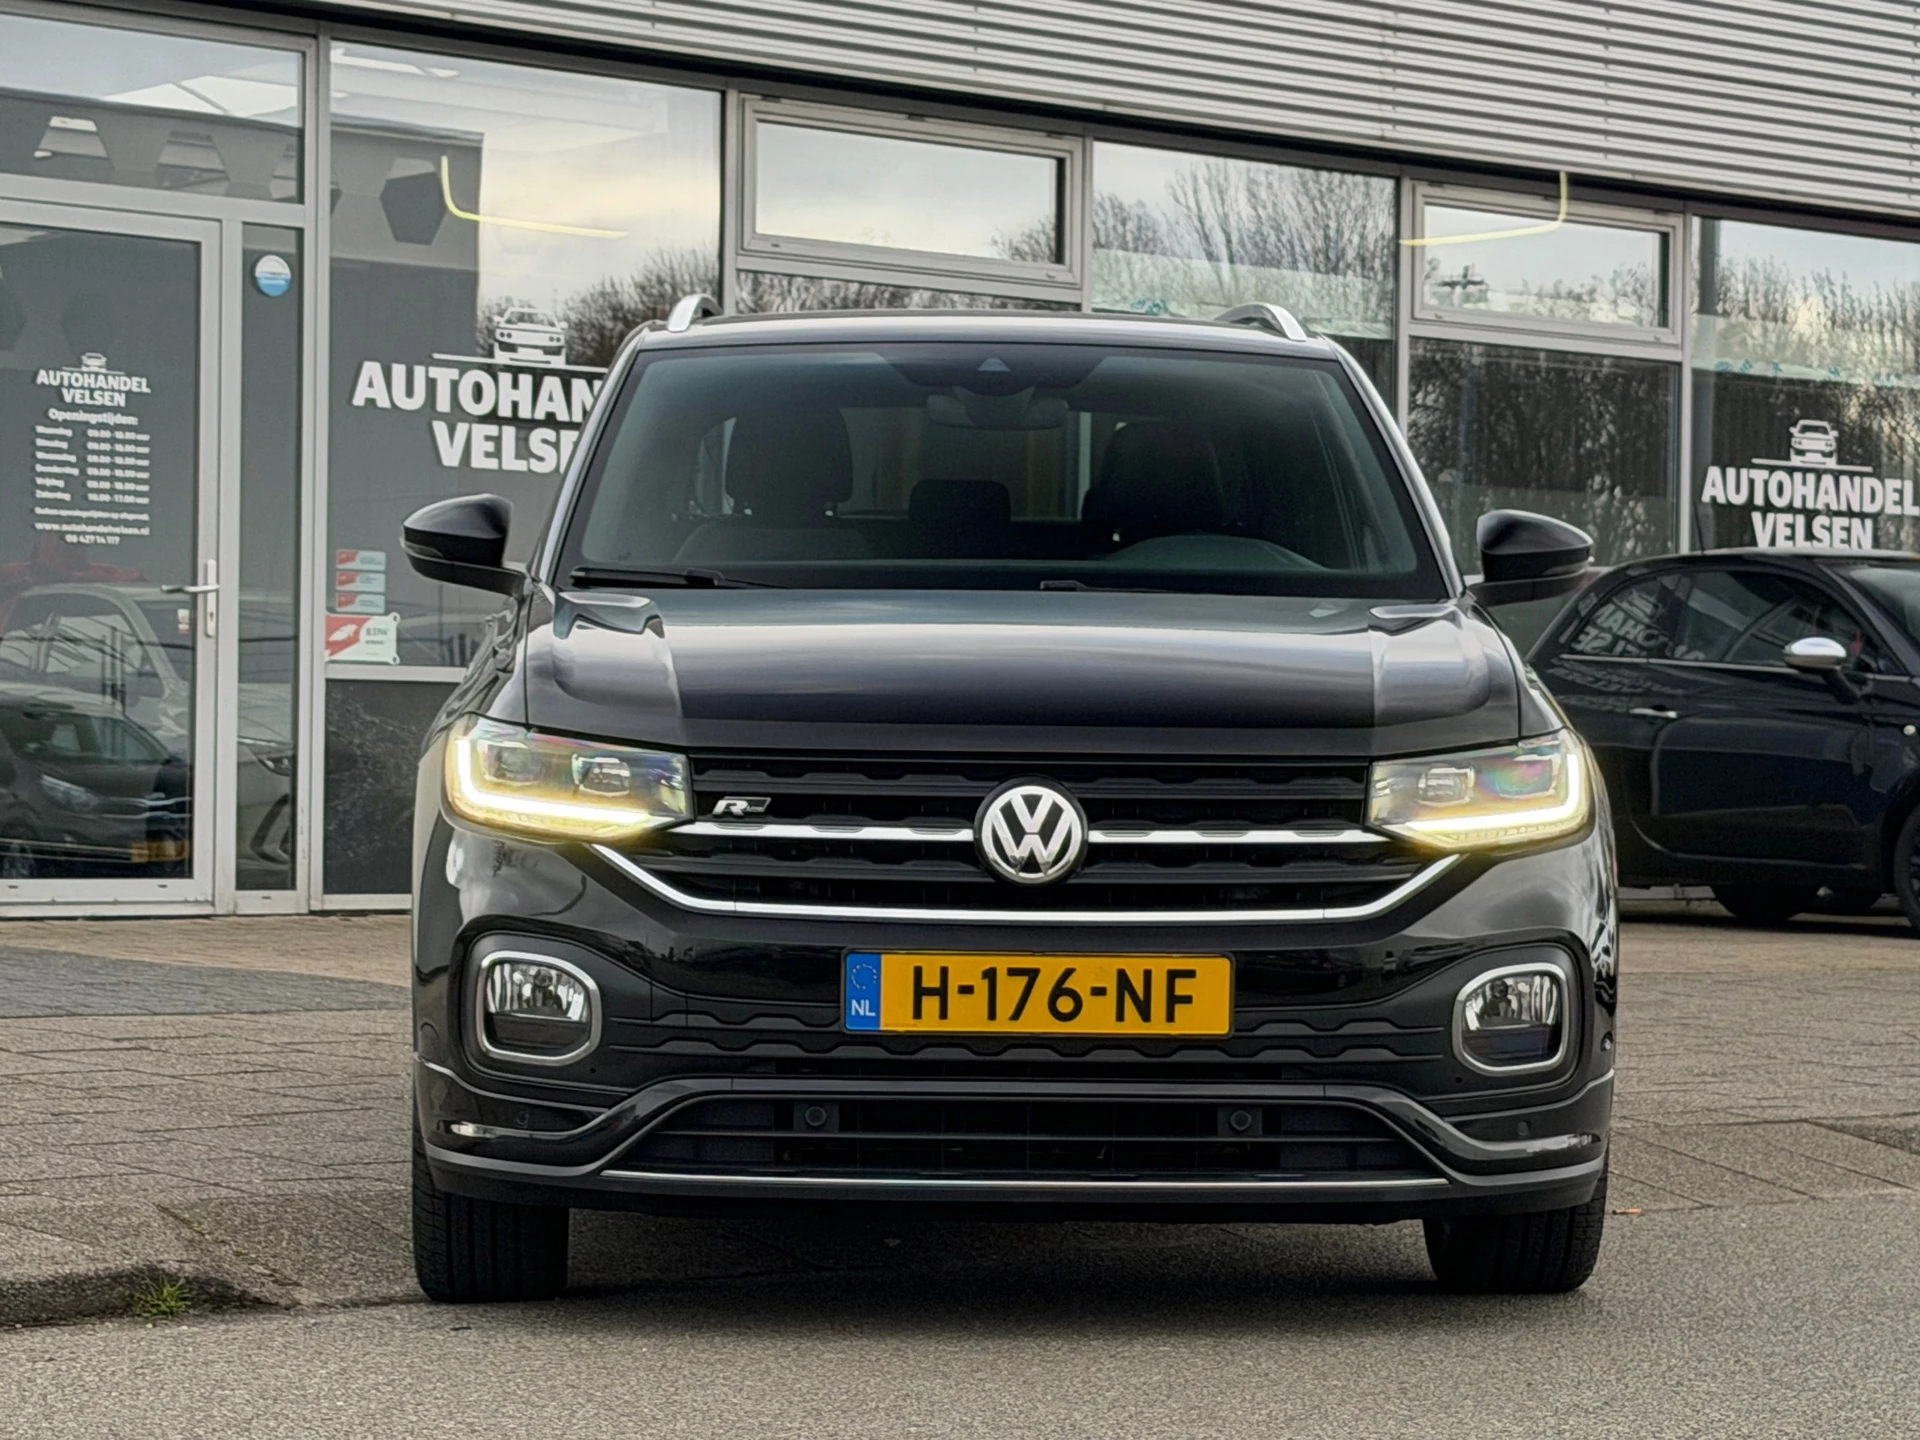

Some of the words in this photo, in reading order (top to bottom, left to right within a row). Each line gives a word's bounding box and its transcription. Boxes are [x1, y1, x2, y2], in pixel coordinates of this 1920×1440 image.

[36, 369, 151, 393] AUTOHANDEL
[61, 387, 126, 407] VELSEN
[1701, 466, 1920, 516] AUTOHANDEL
[1751, 511, 1873, 550] VELSEN
[851, 999, 876, 1017] NL
[912, 965, 1198, 1024] H-176-NF
